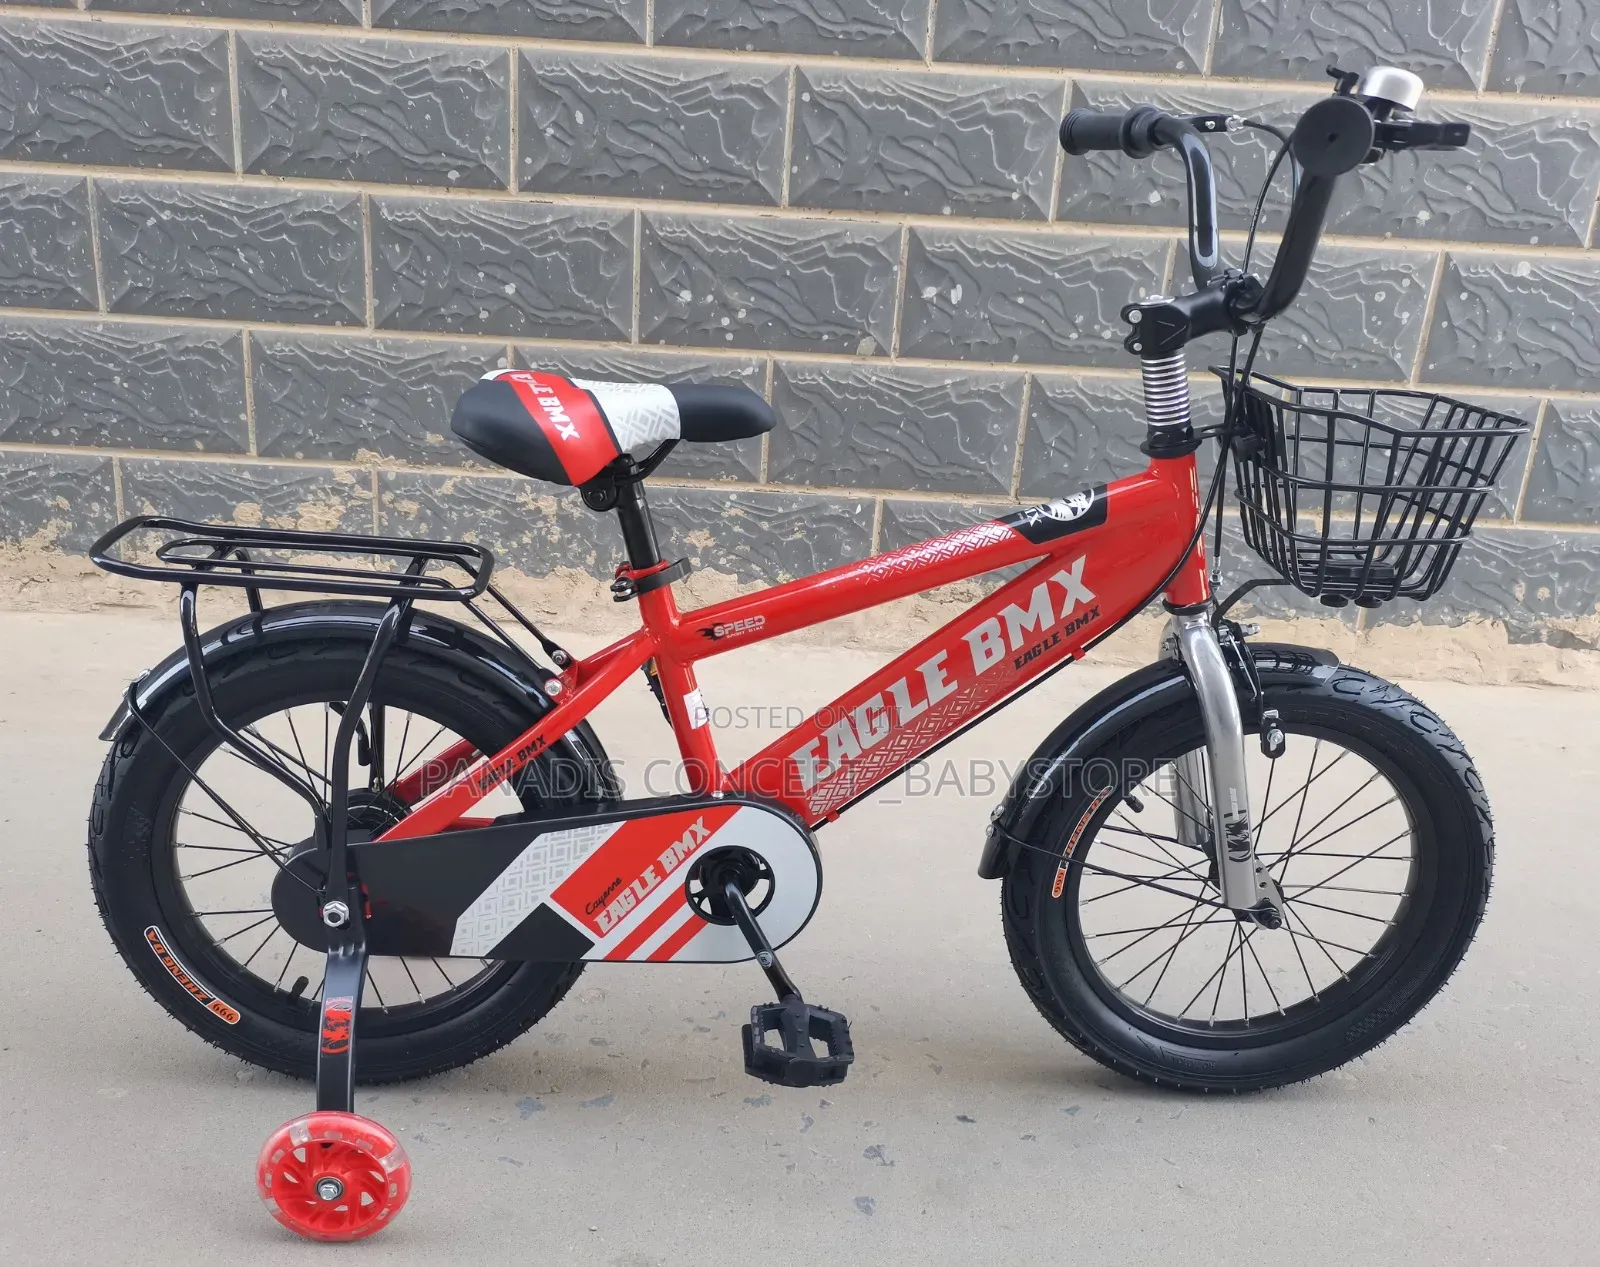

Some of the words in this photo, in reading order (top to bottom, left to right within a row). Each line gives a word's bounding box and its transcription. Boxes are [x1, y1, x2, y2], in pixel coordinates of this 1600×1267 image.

[537, 394, 580, 441] BMX
[713, 615, 766, 636] SPEED
[1013, 632, 1061, 670] EAGLE
[1066, 604, 1101, 638] BMX
[788, 649, 959, 793] EAGLE
[961, 553, 1096, 676] BMX
[518, 735, 547, 762] BMX
[585, 876, 623, 915] Cayenne
[594, 864, 662, 934] EAGLE
[658, 816, 713, 874] BMX
[147, 928, 166, 955] DA
[162, 956, 210, 1001] ZHENG
